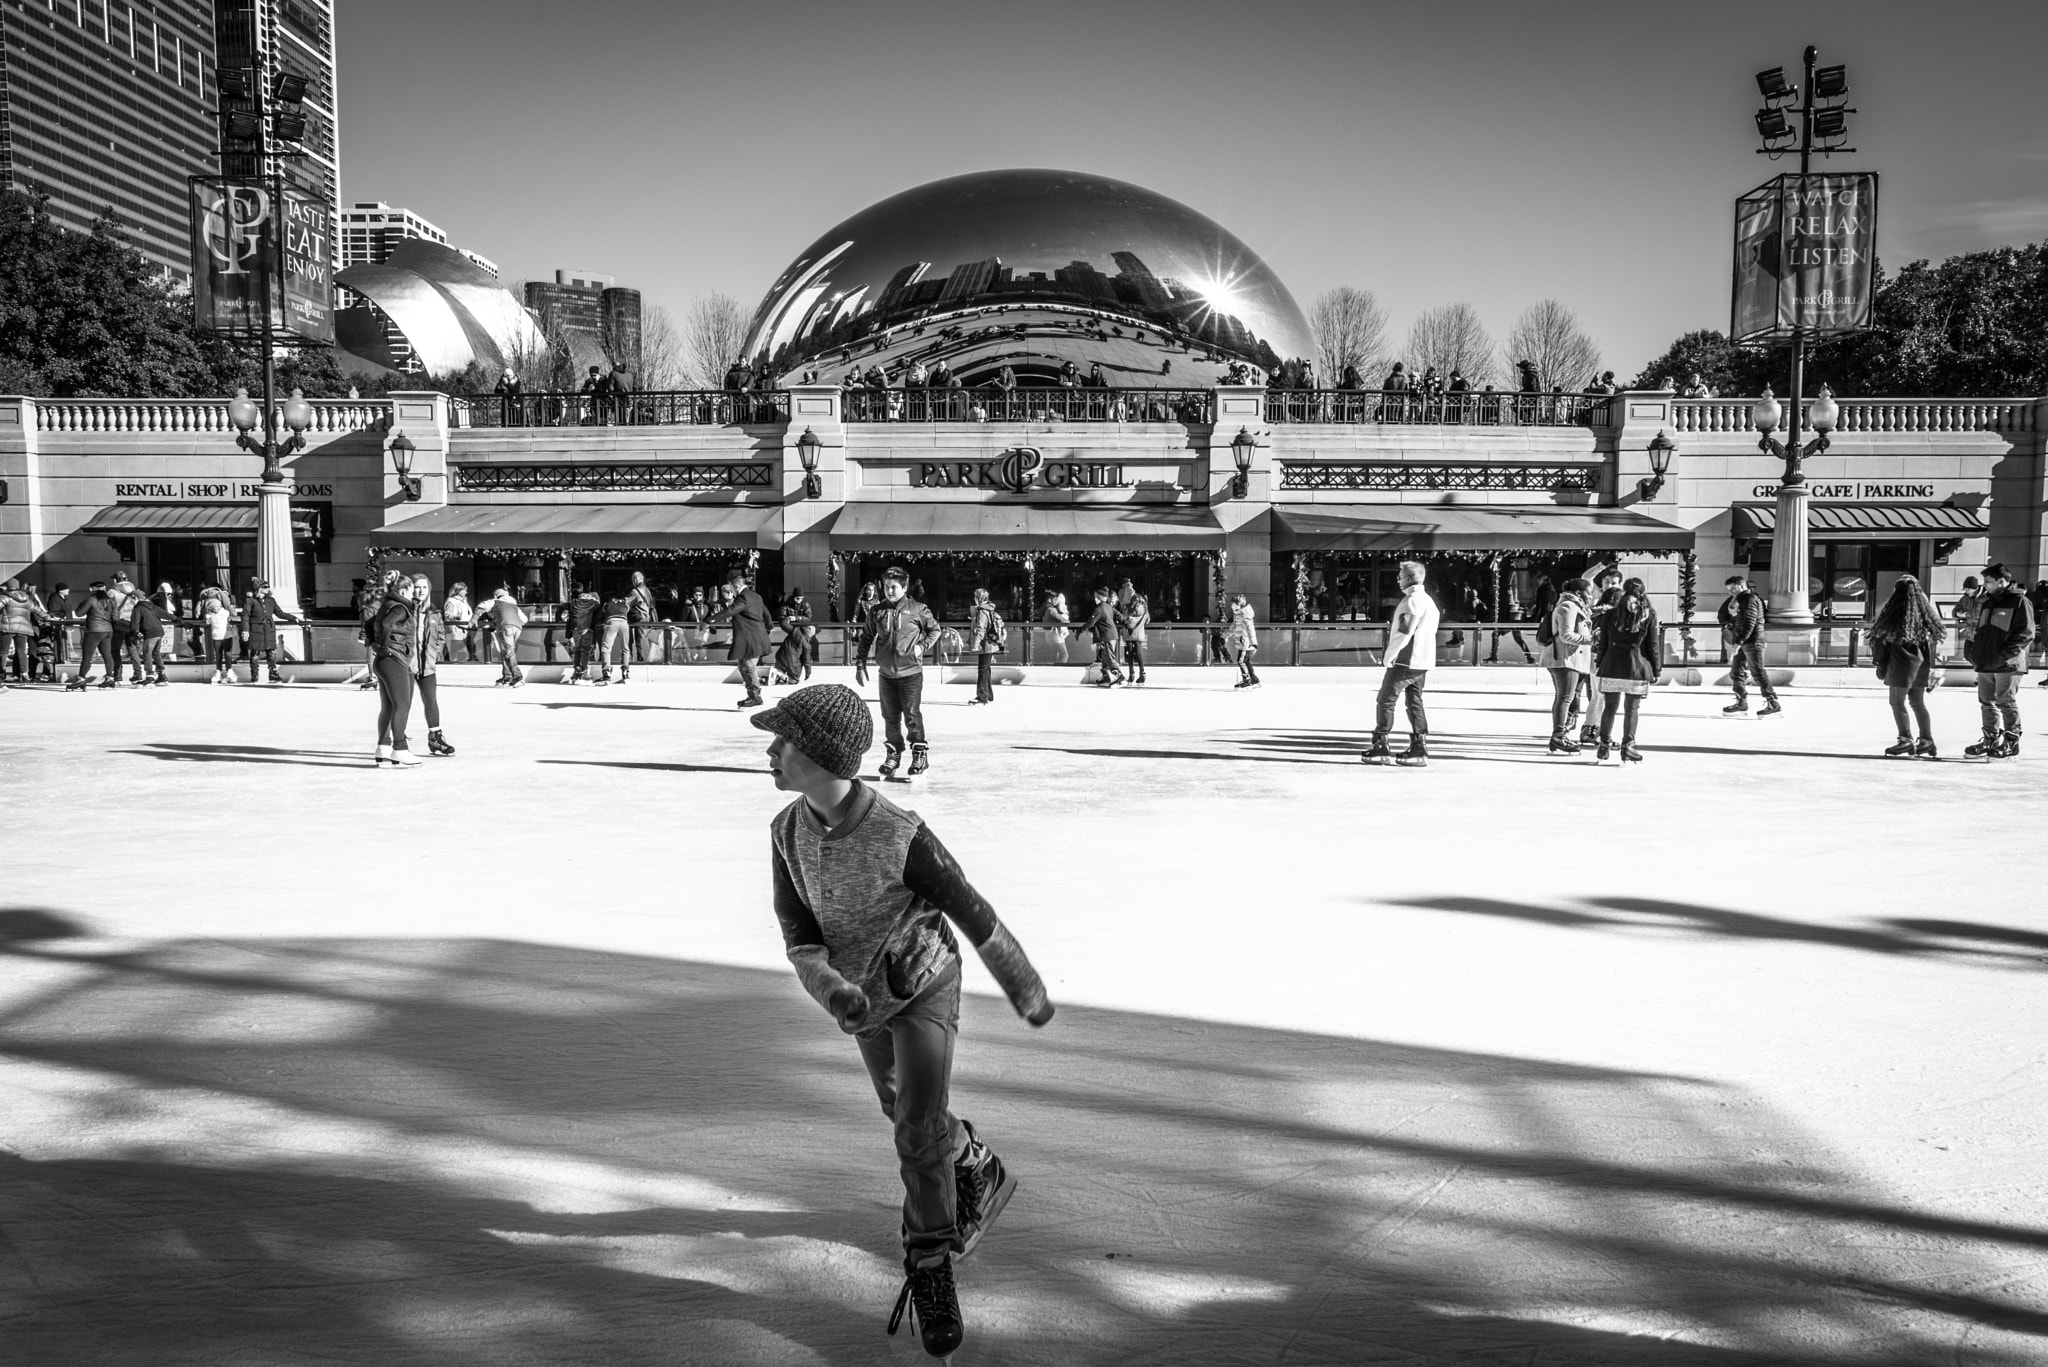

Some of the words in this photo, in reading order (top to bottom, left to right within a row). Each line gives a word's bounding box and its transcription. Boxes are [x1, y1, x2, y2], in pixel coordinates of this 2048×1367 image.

[1792, 190, 1869, 206] WATCH
[284, 196, 325, 232] TASTE
[1790, 216, 1868, 235] RELAX
[286, 219, 325, 263] EAT
[1789, 247, 1867, 265] LISTEN
[286, 253, 325, 284] ENJOY
[1792, 296, 1817, 305] PARK
[1831, 296, 1860, 305] GRILL
[920, 463, 1001, 487] PARK
[1045, 463, 1134, 487] GRILL
[115, 484, 177, 497] RENTAL
[188, 484, 228, 497] SHOP
[240, 484, 333, 497] REOOMS
[1812, 485, 1853, 497] CAFE
[1864, 485, 1934, 497] PARKING
